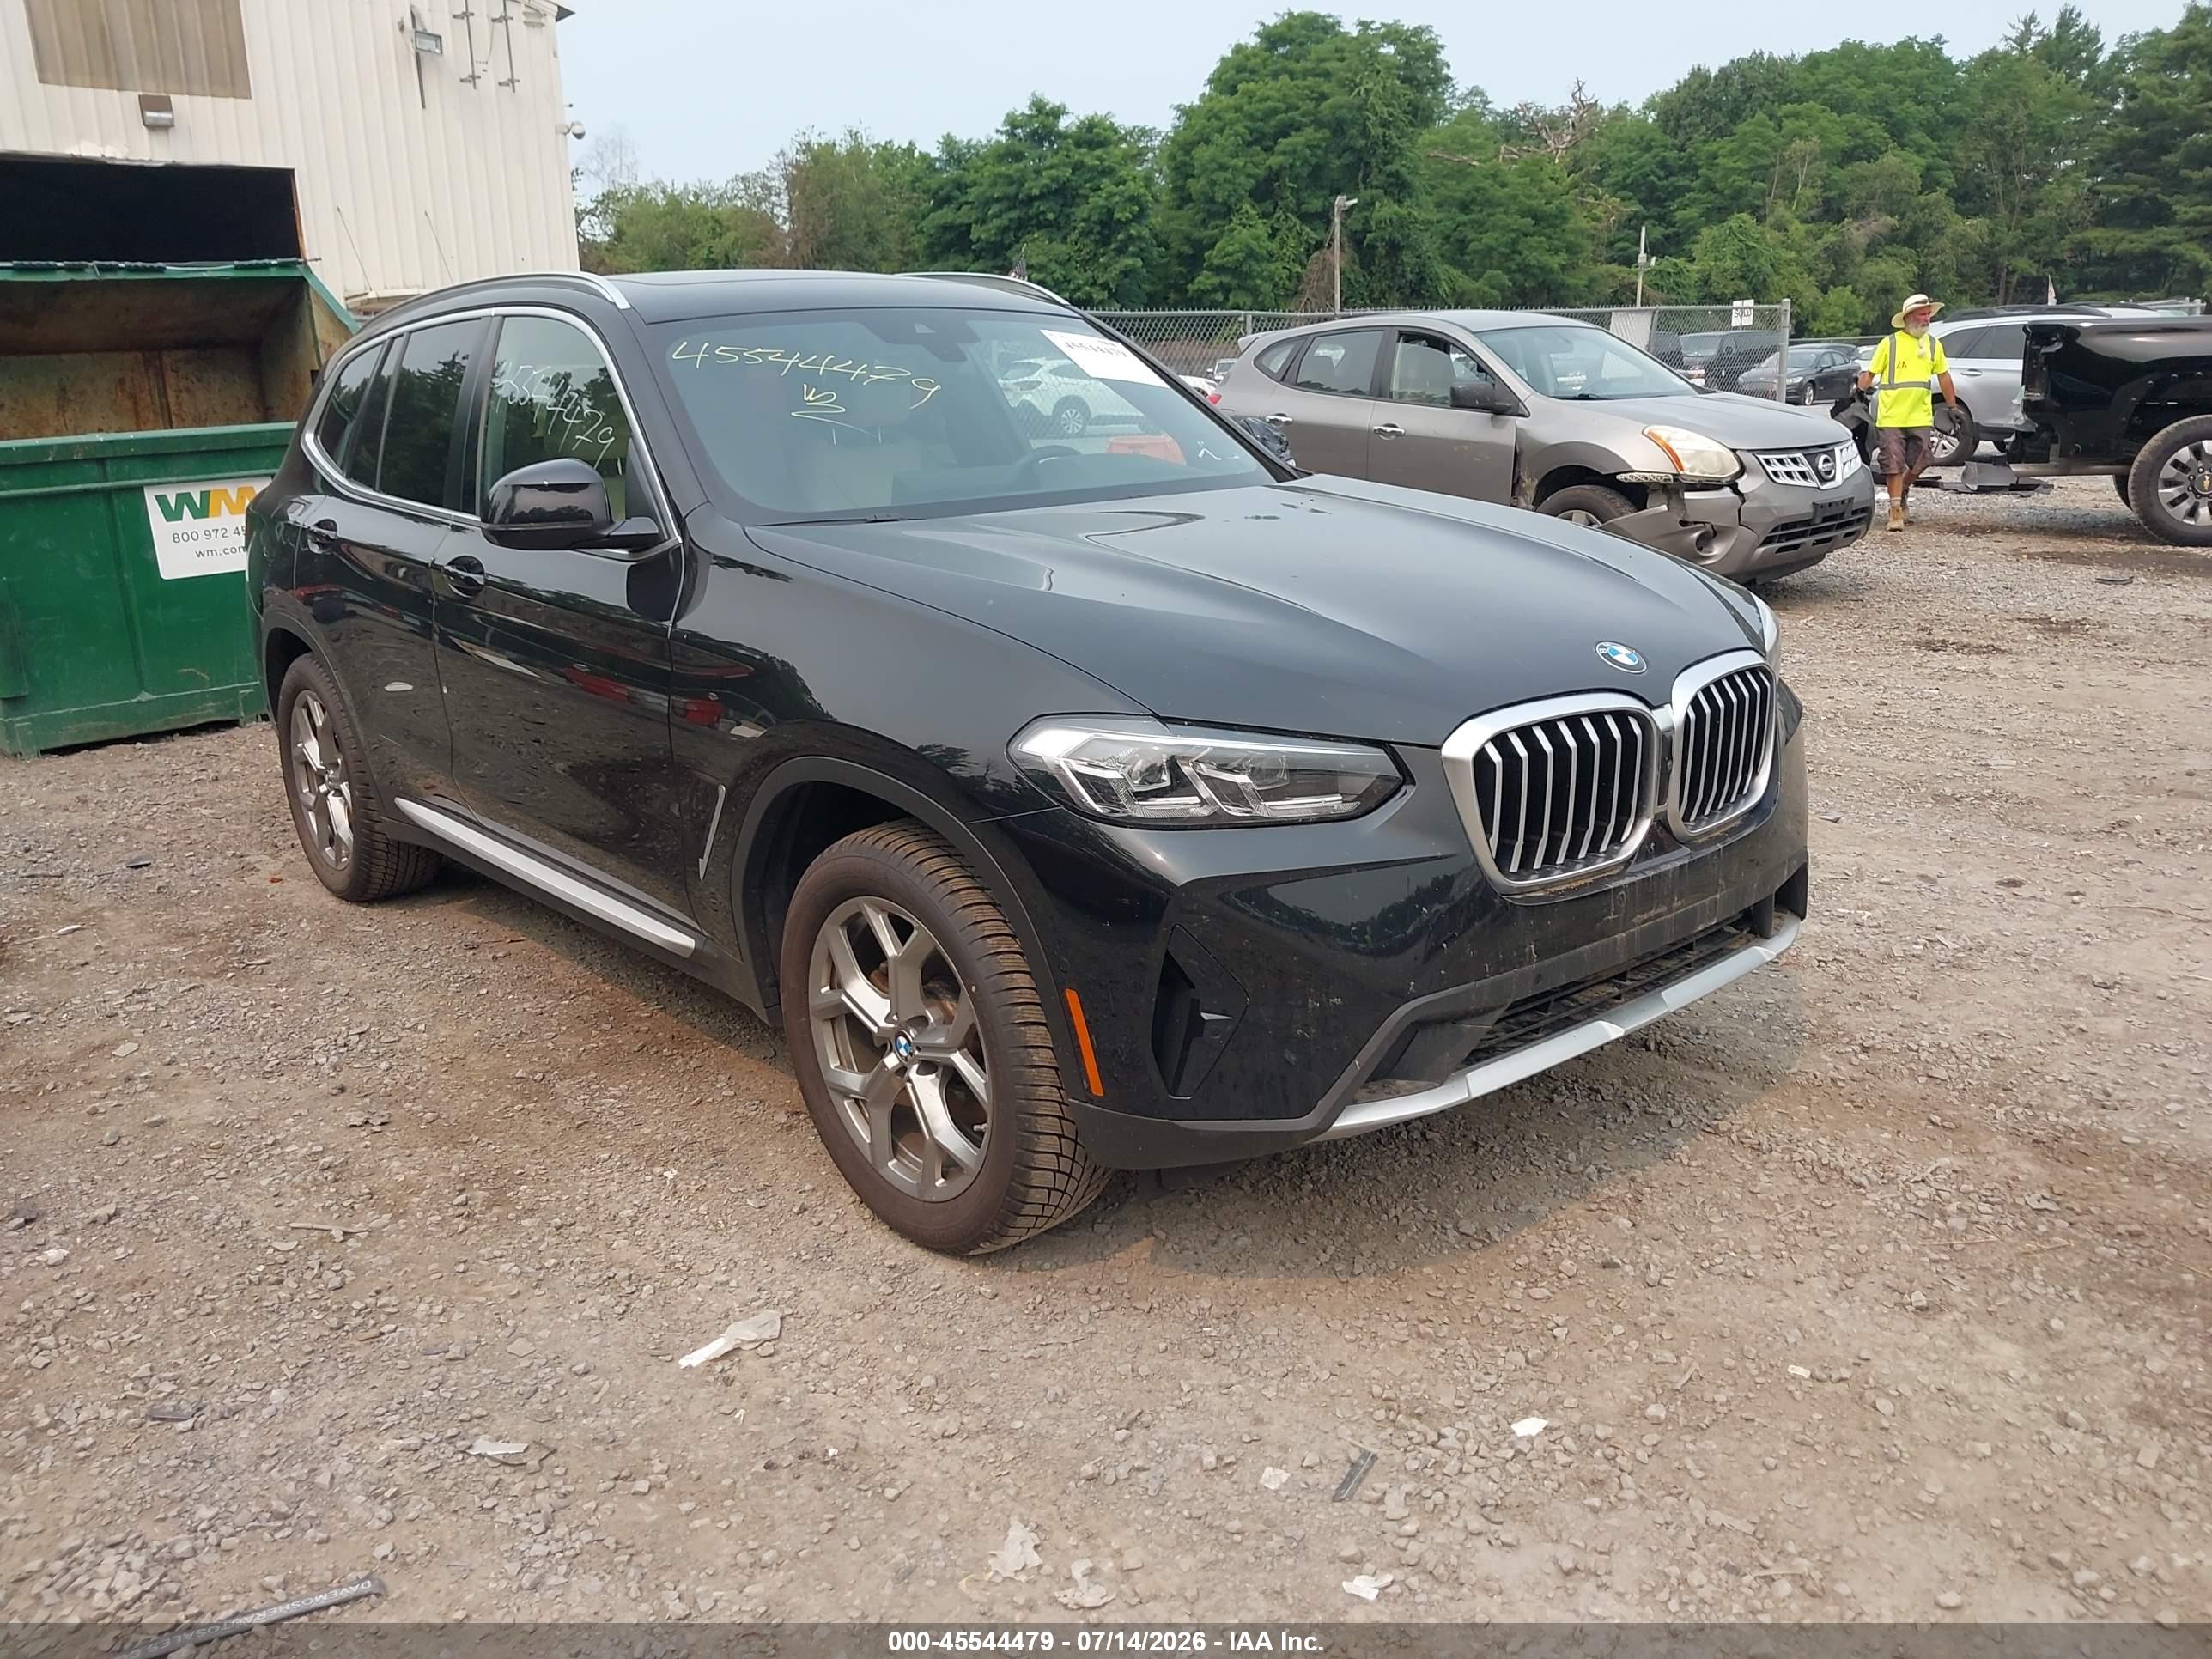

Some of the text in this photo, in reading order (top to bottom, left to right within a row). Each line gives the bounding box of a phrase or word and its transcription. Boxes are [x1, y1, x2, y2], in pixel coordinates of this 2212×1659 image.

[672, 341, 942, 410] 45544479
[154, 486, 258, 522] WM
[172, 526, 246, 544] 800 972 45
